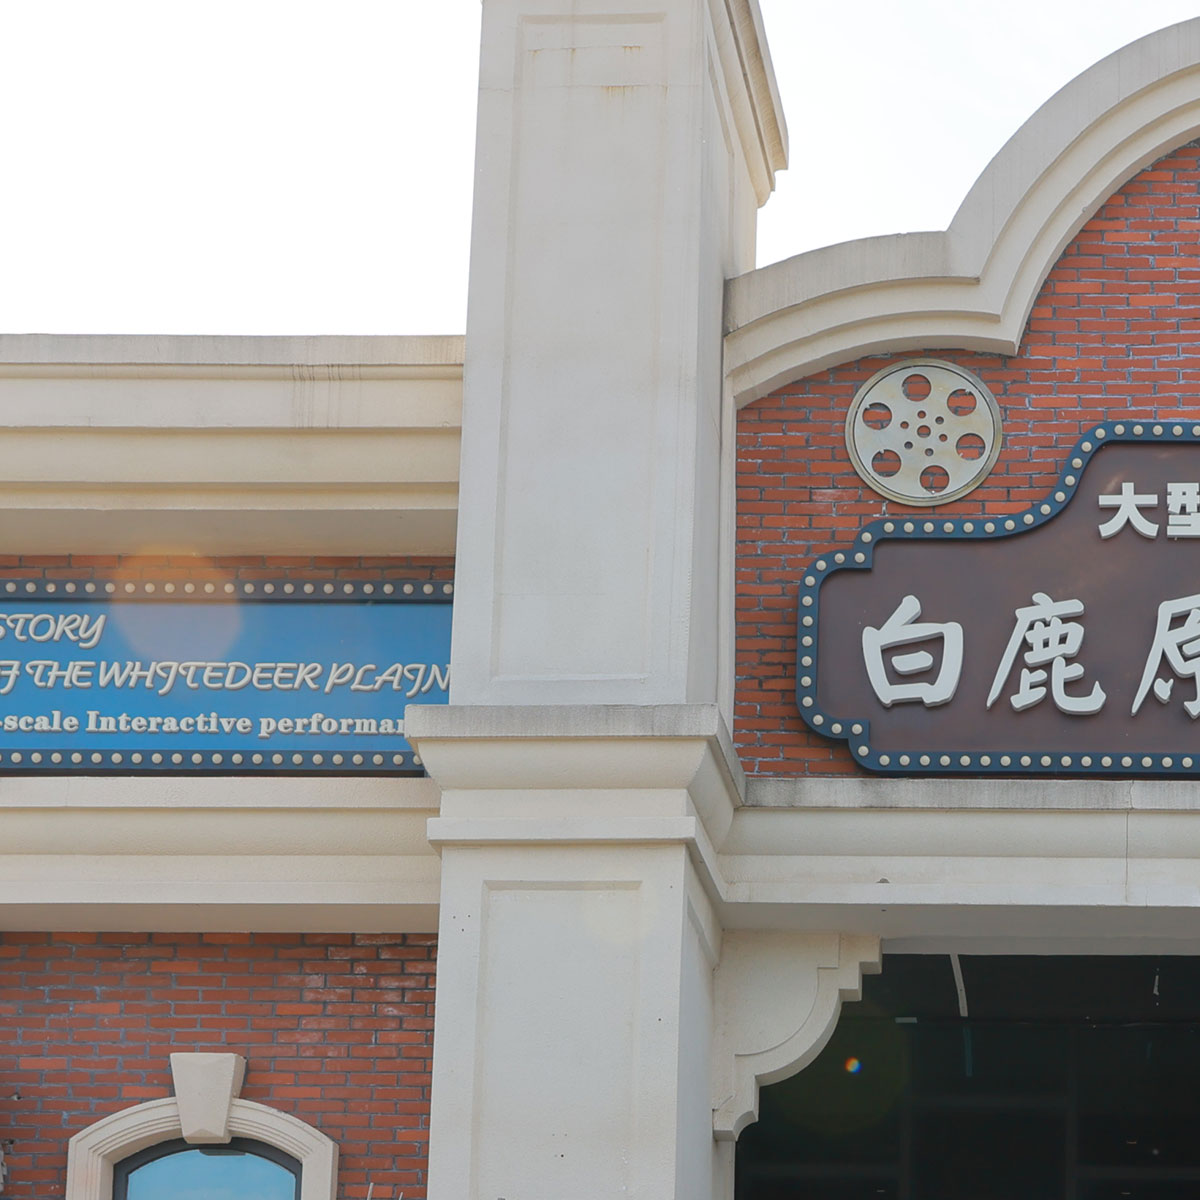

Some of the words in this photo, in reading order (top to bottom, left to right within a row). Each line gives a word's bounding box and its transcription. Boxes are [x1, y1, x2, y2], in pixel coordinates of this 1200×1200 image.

[25, 660, 97, 689] THE
[98, 660, 323, 696] WHITEDEER
[324, 662, 450, 698] PLAIN
[85, 710, 252, 734] Interactive
